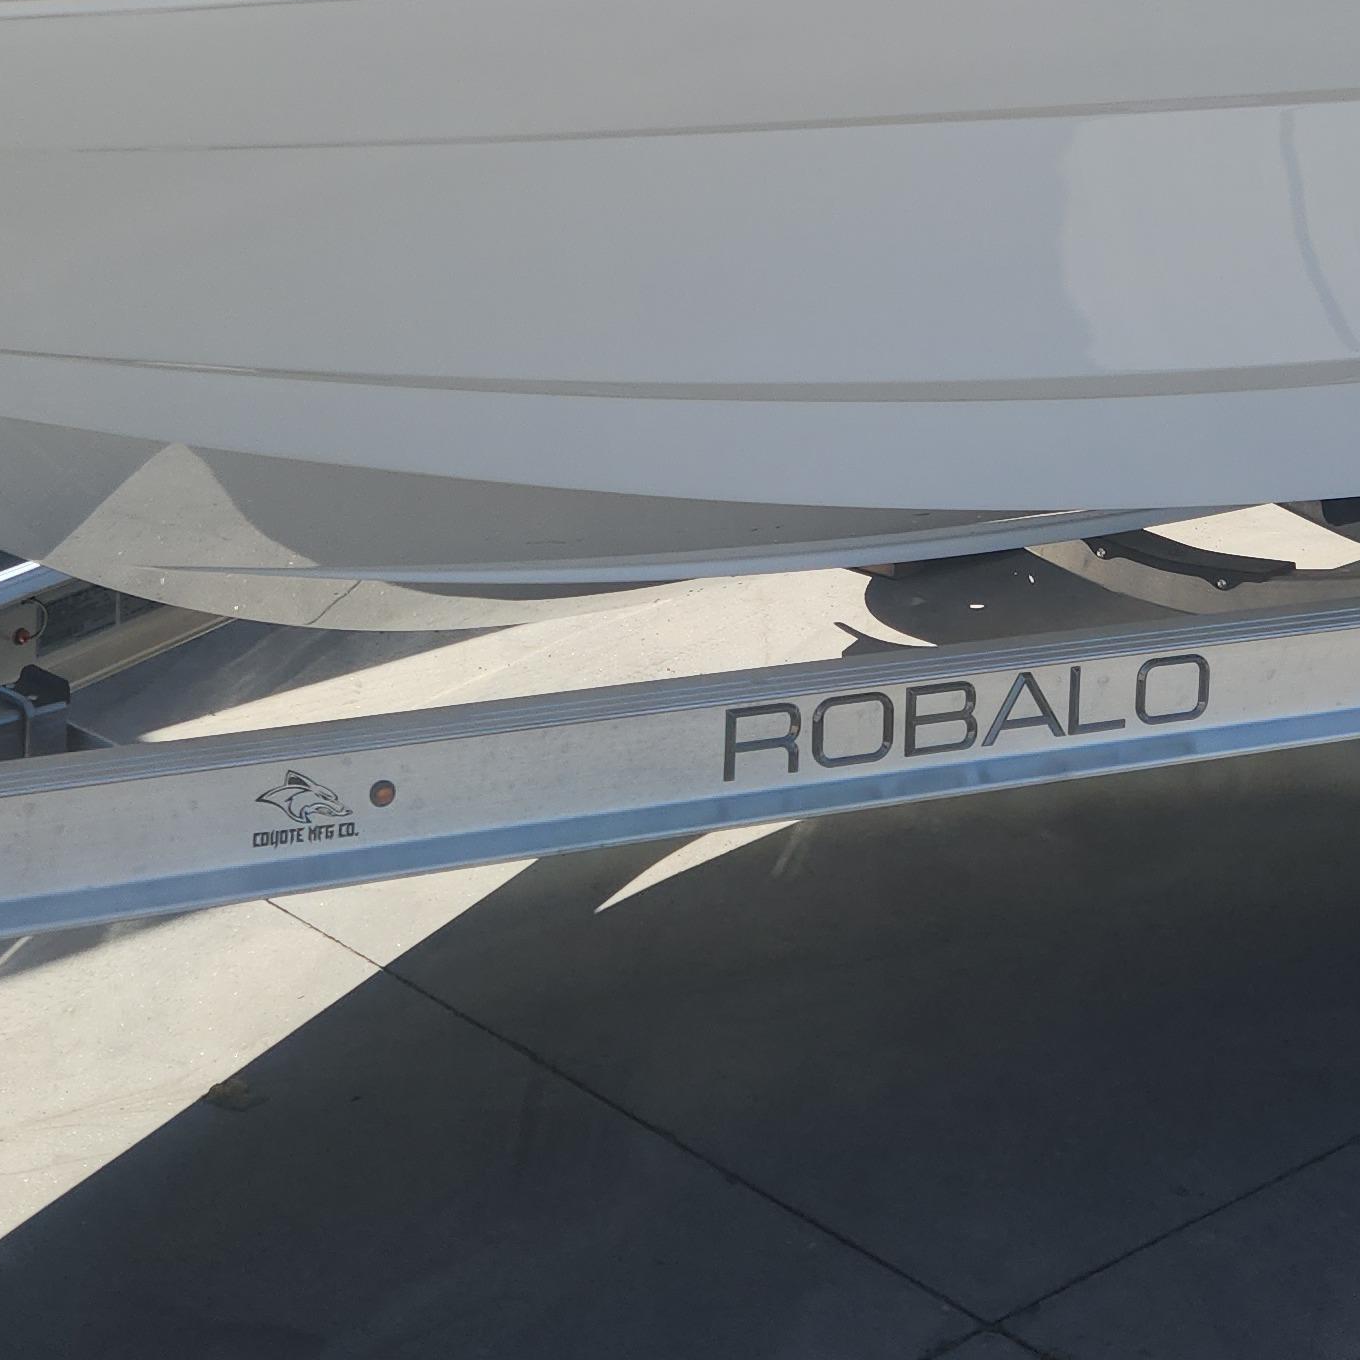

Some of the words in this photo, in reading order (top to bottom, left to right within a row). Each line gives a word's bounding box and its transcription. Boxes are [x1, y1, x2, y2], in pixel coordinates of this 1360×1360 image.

[723, 653, 1210, 782] ROBALO
[252, 827, 305, 850] COYOTE
[307, 823, 336, 844] MFG
